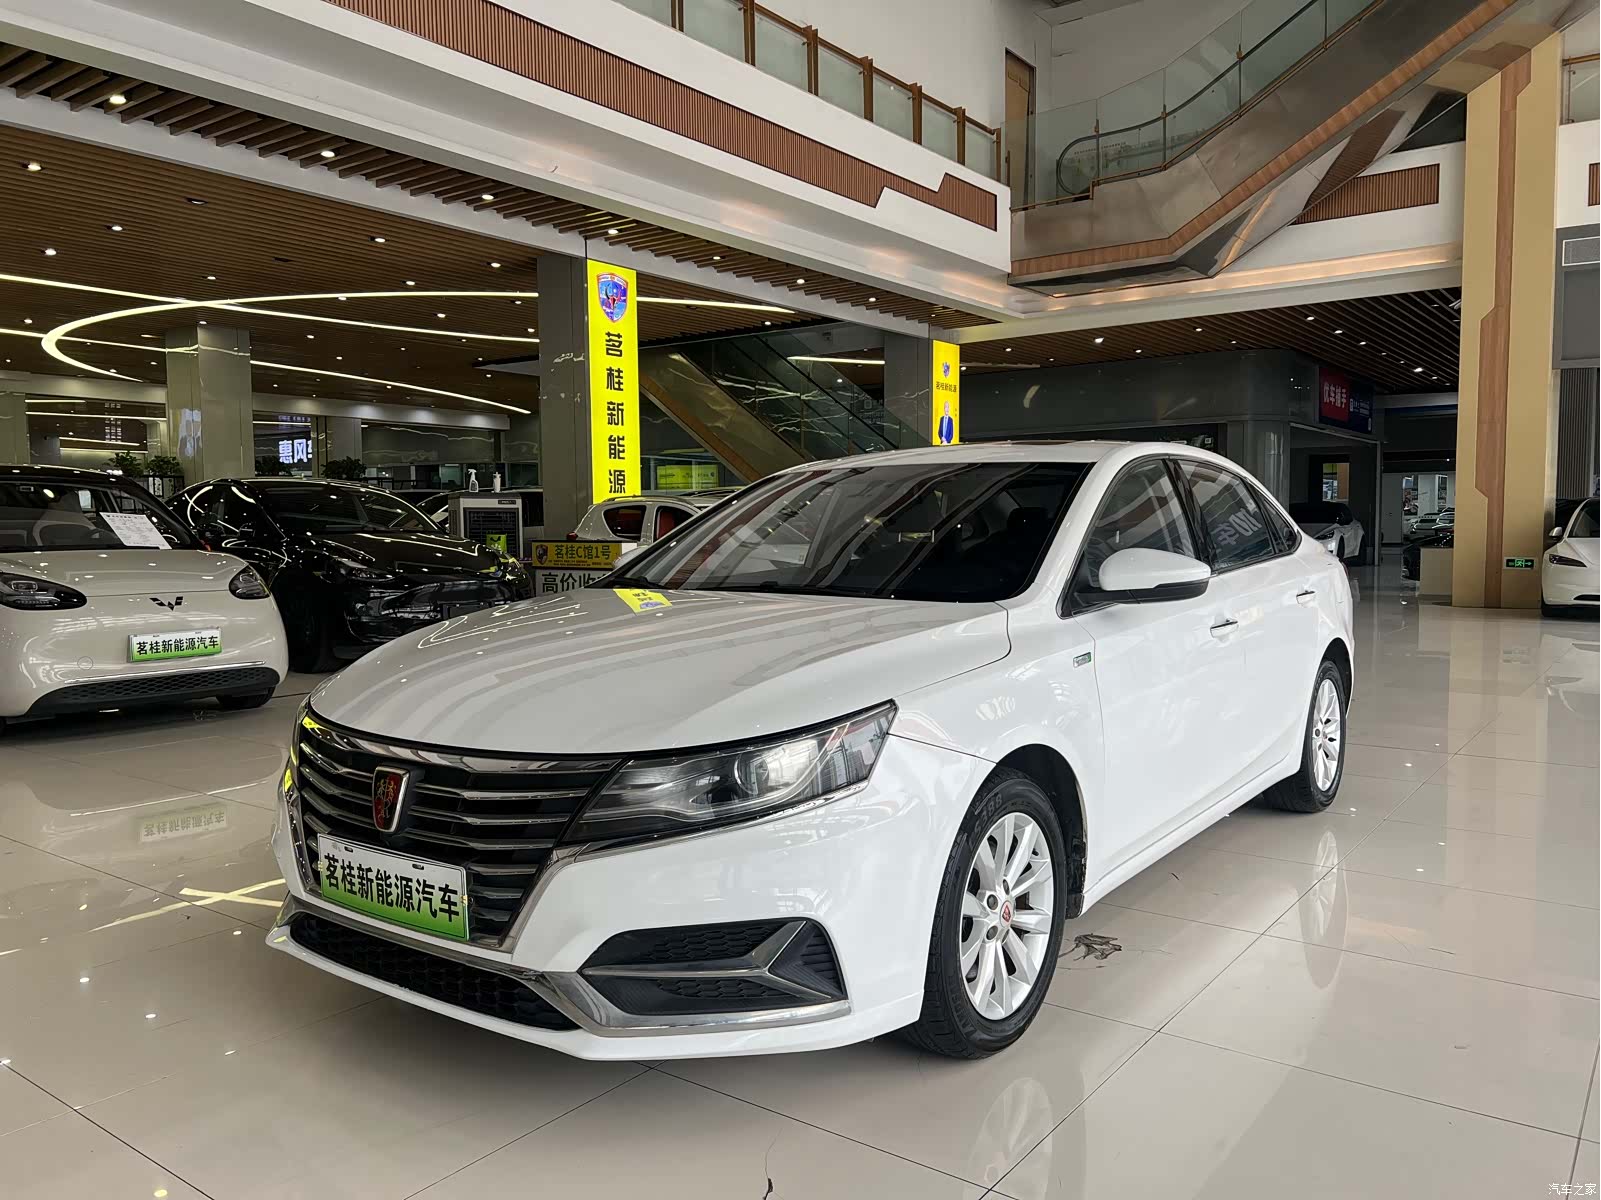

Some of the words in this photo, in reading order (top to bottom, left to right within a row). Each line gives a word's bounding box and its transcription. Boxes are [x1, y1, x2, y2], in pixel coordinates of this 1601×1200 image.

[605, 332, 626, 494] 茗桂新能源
[554, 545, 611, 559] 茗桂C馆1号
[136, 636, 219, 655] 茗桂新能源汽车
[324, 852, 459, 922] 茗桂新能源汽车
